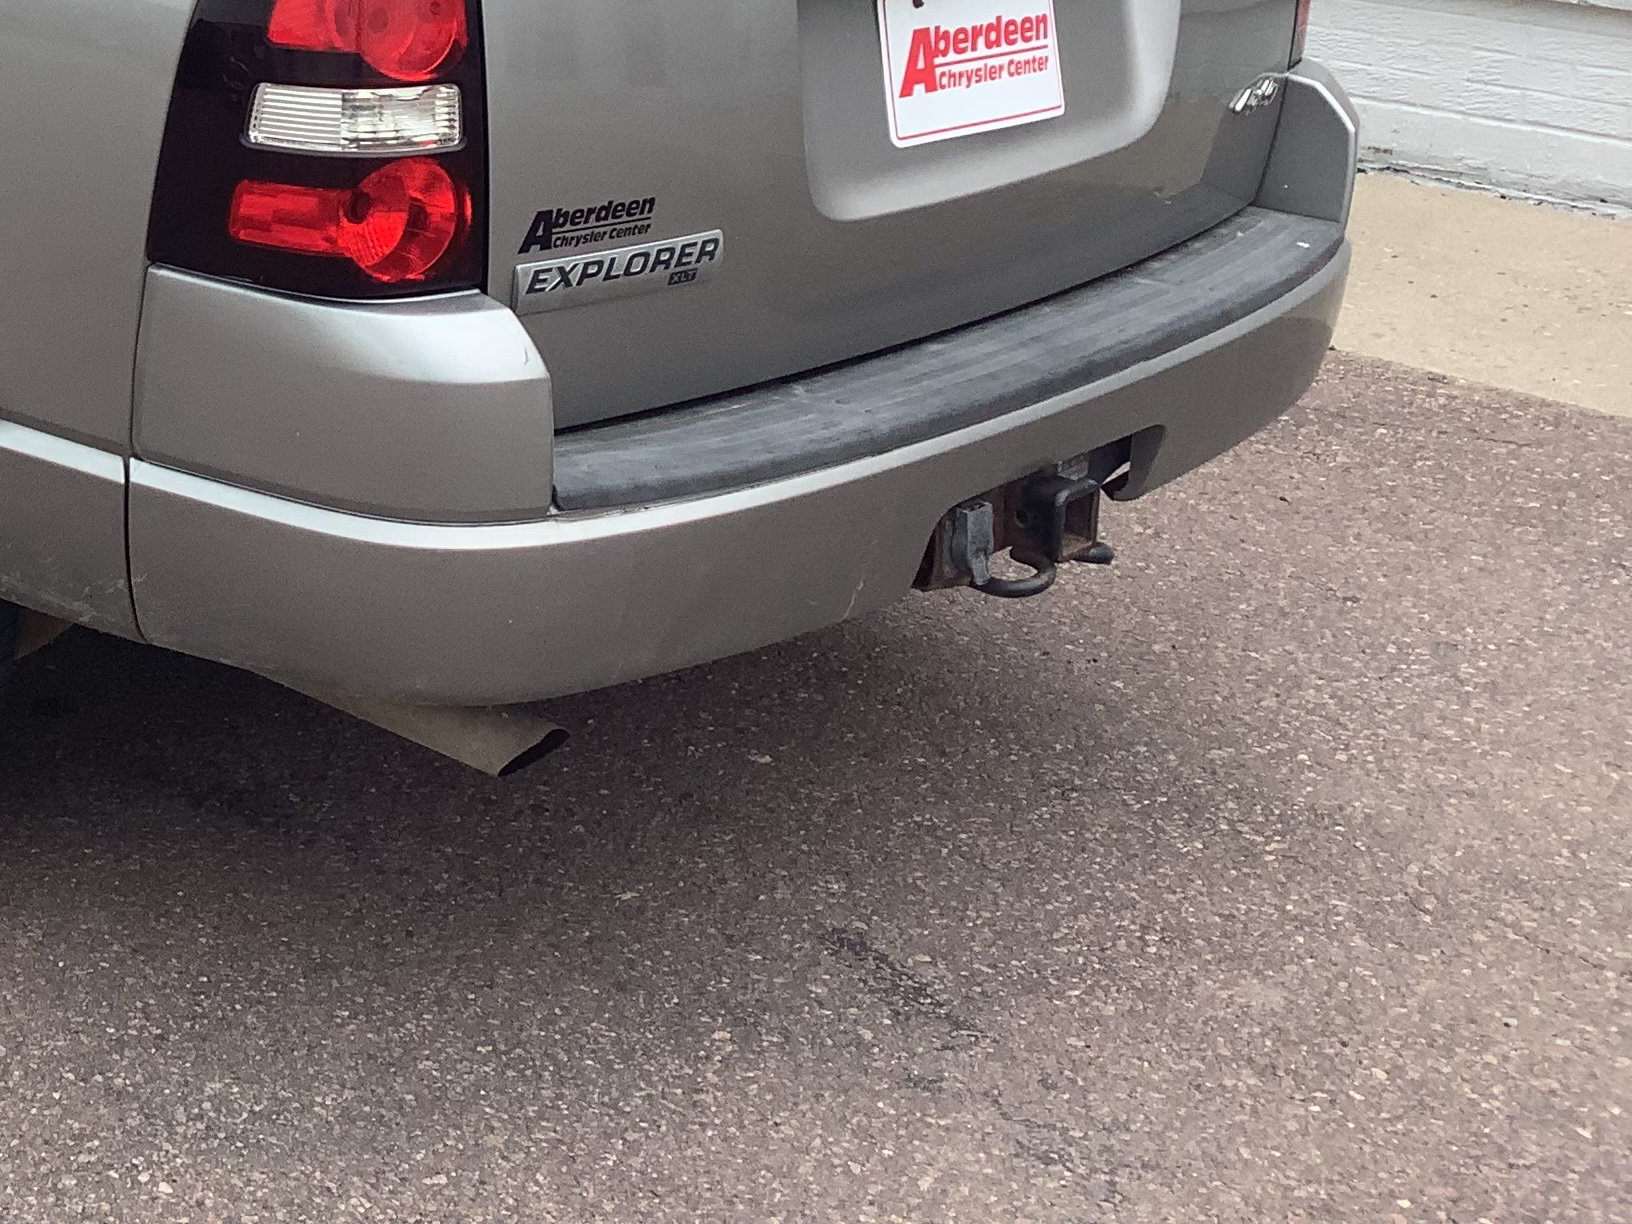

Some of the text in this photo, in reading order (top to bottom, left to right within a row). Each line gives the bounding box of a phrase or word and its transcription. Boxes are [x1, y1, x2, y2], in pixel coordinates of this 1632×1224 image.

[899, 13, 1048, 98] Aberdeen
[938, 55, 1049, 89] Chrysler Center
[518, 196, 656, 254] Aberdeen
[552, 223, 652, 250] Chrysler Center
[525, 237, 721, 295] EXPLORER
